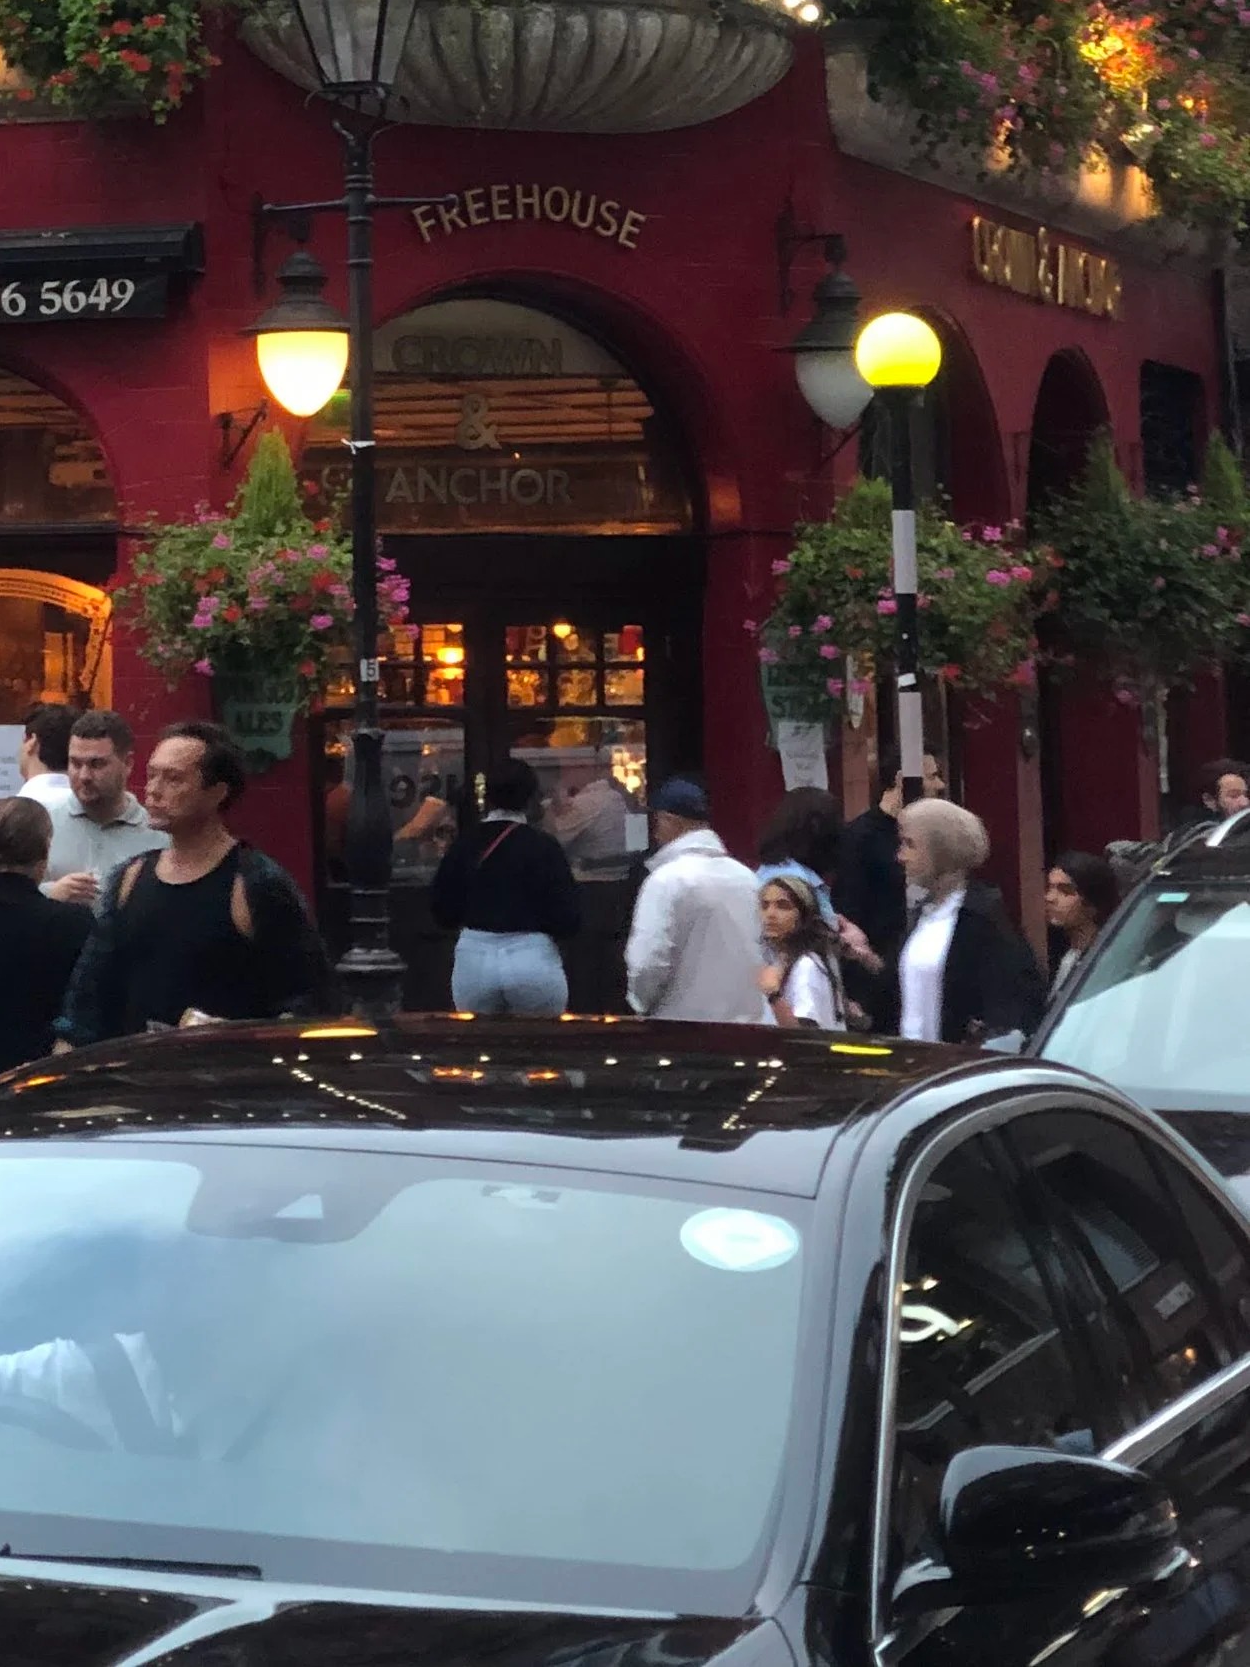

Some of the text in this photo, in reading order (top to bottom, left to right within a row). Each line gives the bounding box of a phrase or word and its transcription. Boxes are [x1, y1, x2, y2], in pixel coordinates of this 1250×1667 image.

[411, 183, 647, 250] FREEHOUSE
[39, 277, 135, 315] 5649
[391, 333, 564, 374] CROWN
[456, 393, 502, 450] &
[385, 467, 573, 505] ANCHOR
